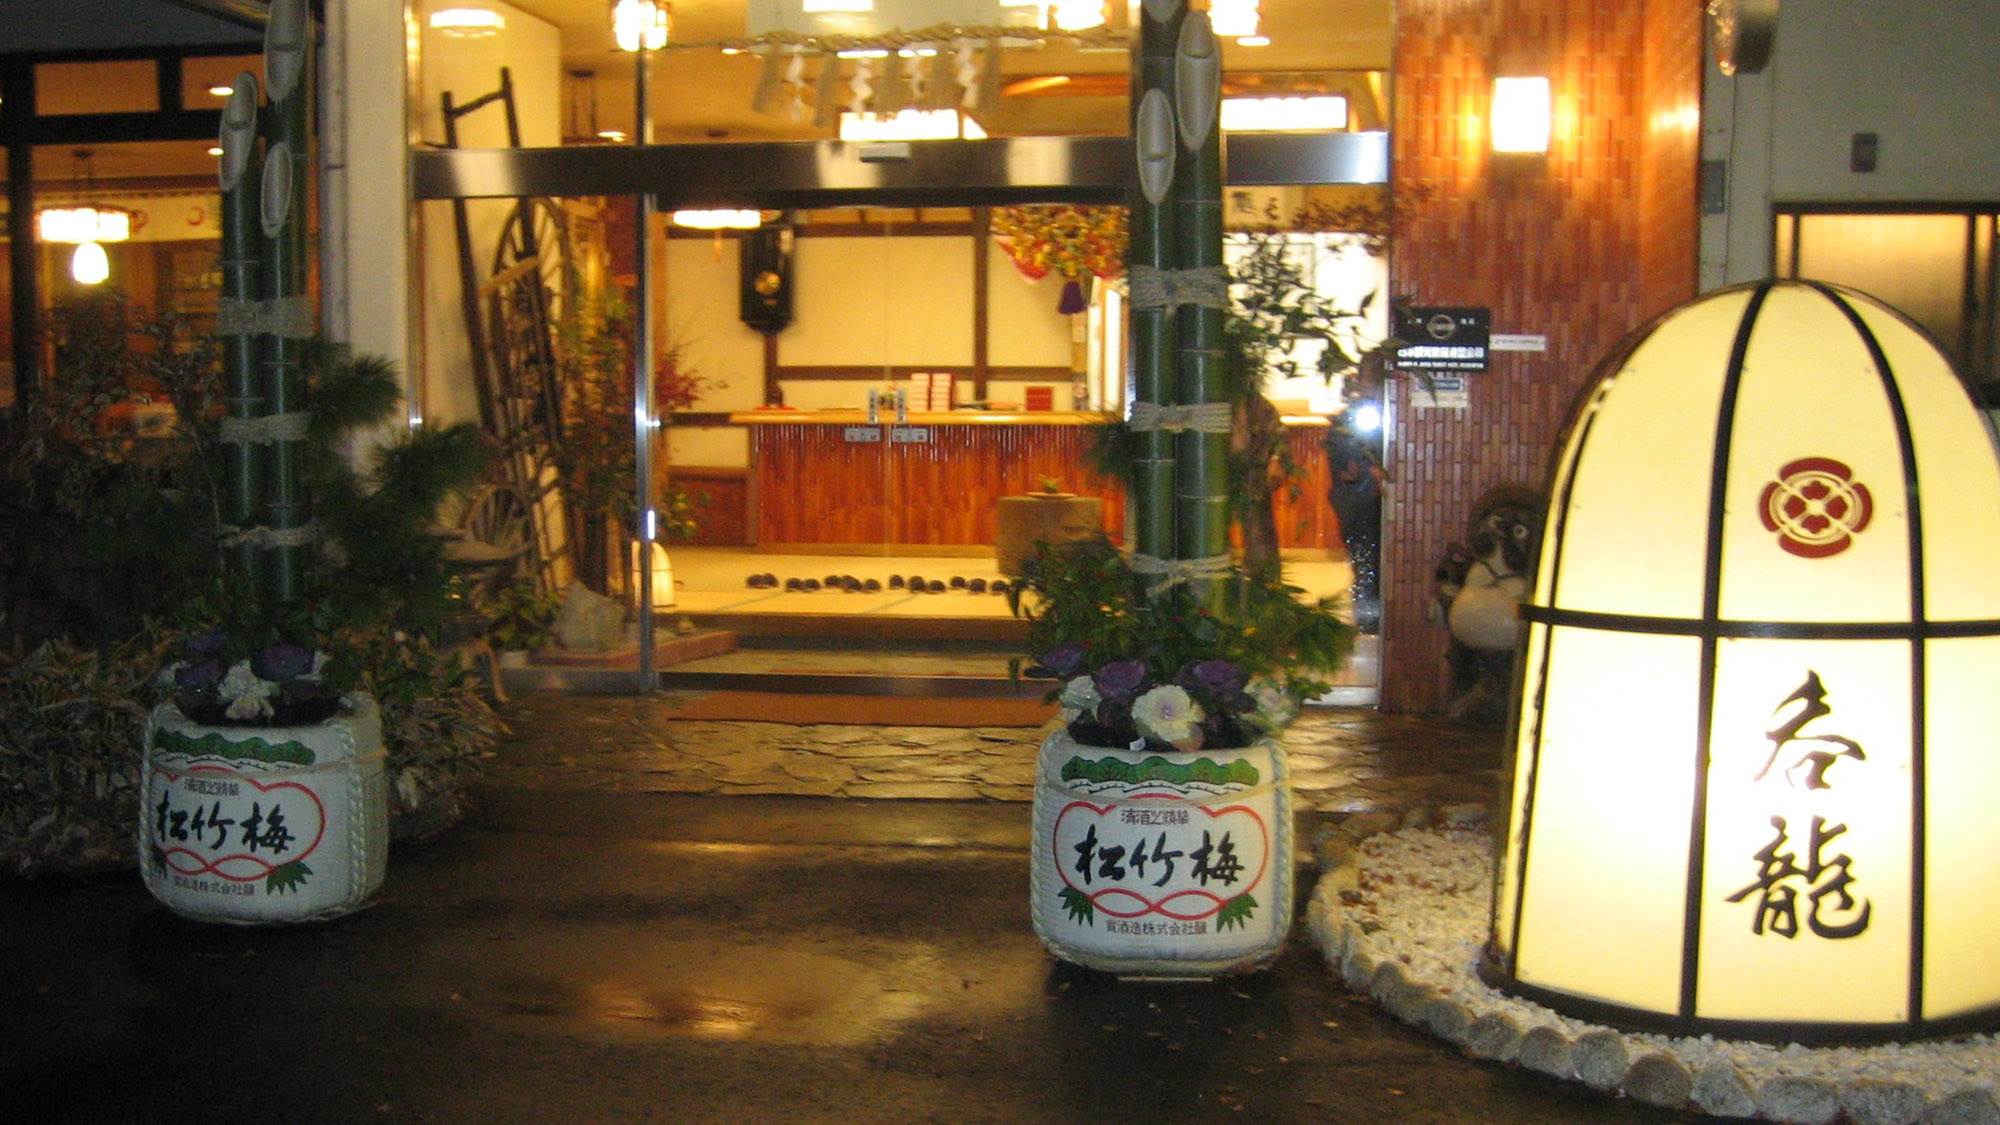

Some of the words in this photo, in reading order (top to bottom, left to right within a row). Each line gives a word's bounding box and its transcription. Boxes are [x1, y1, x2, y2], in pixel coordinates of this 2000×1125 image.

[156, 791, 296, 854] 松竹梅
[1074, 824, 1244, 887] 松竹梅
